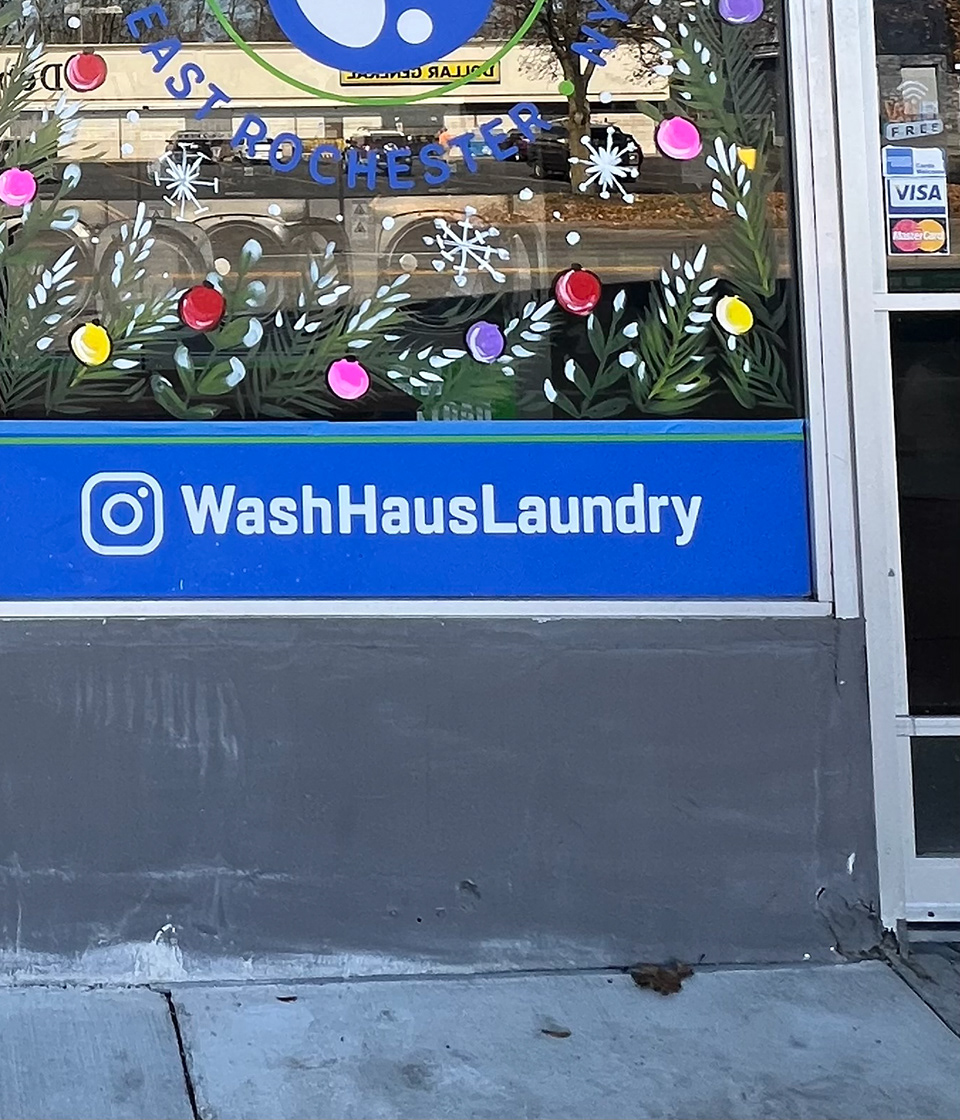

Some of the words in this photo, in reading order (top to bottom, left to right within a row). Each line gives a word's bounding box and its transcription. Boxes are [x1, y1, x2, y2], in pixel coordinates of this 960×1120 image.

[124, 5, 231, 119] EAST
[232, 102, 552, 190] ROCHESTER
[891, 123, 939, 137] FREE
[895, 184, 942, 200] VISA
[181, 483, 703, 546] WashHausLaundry
